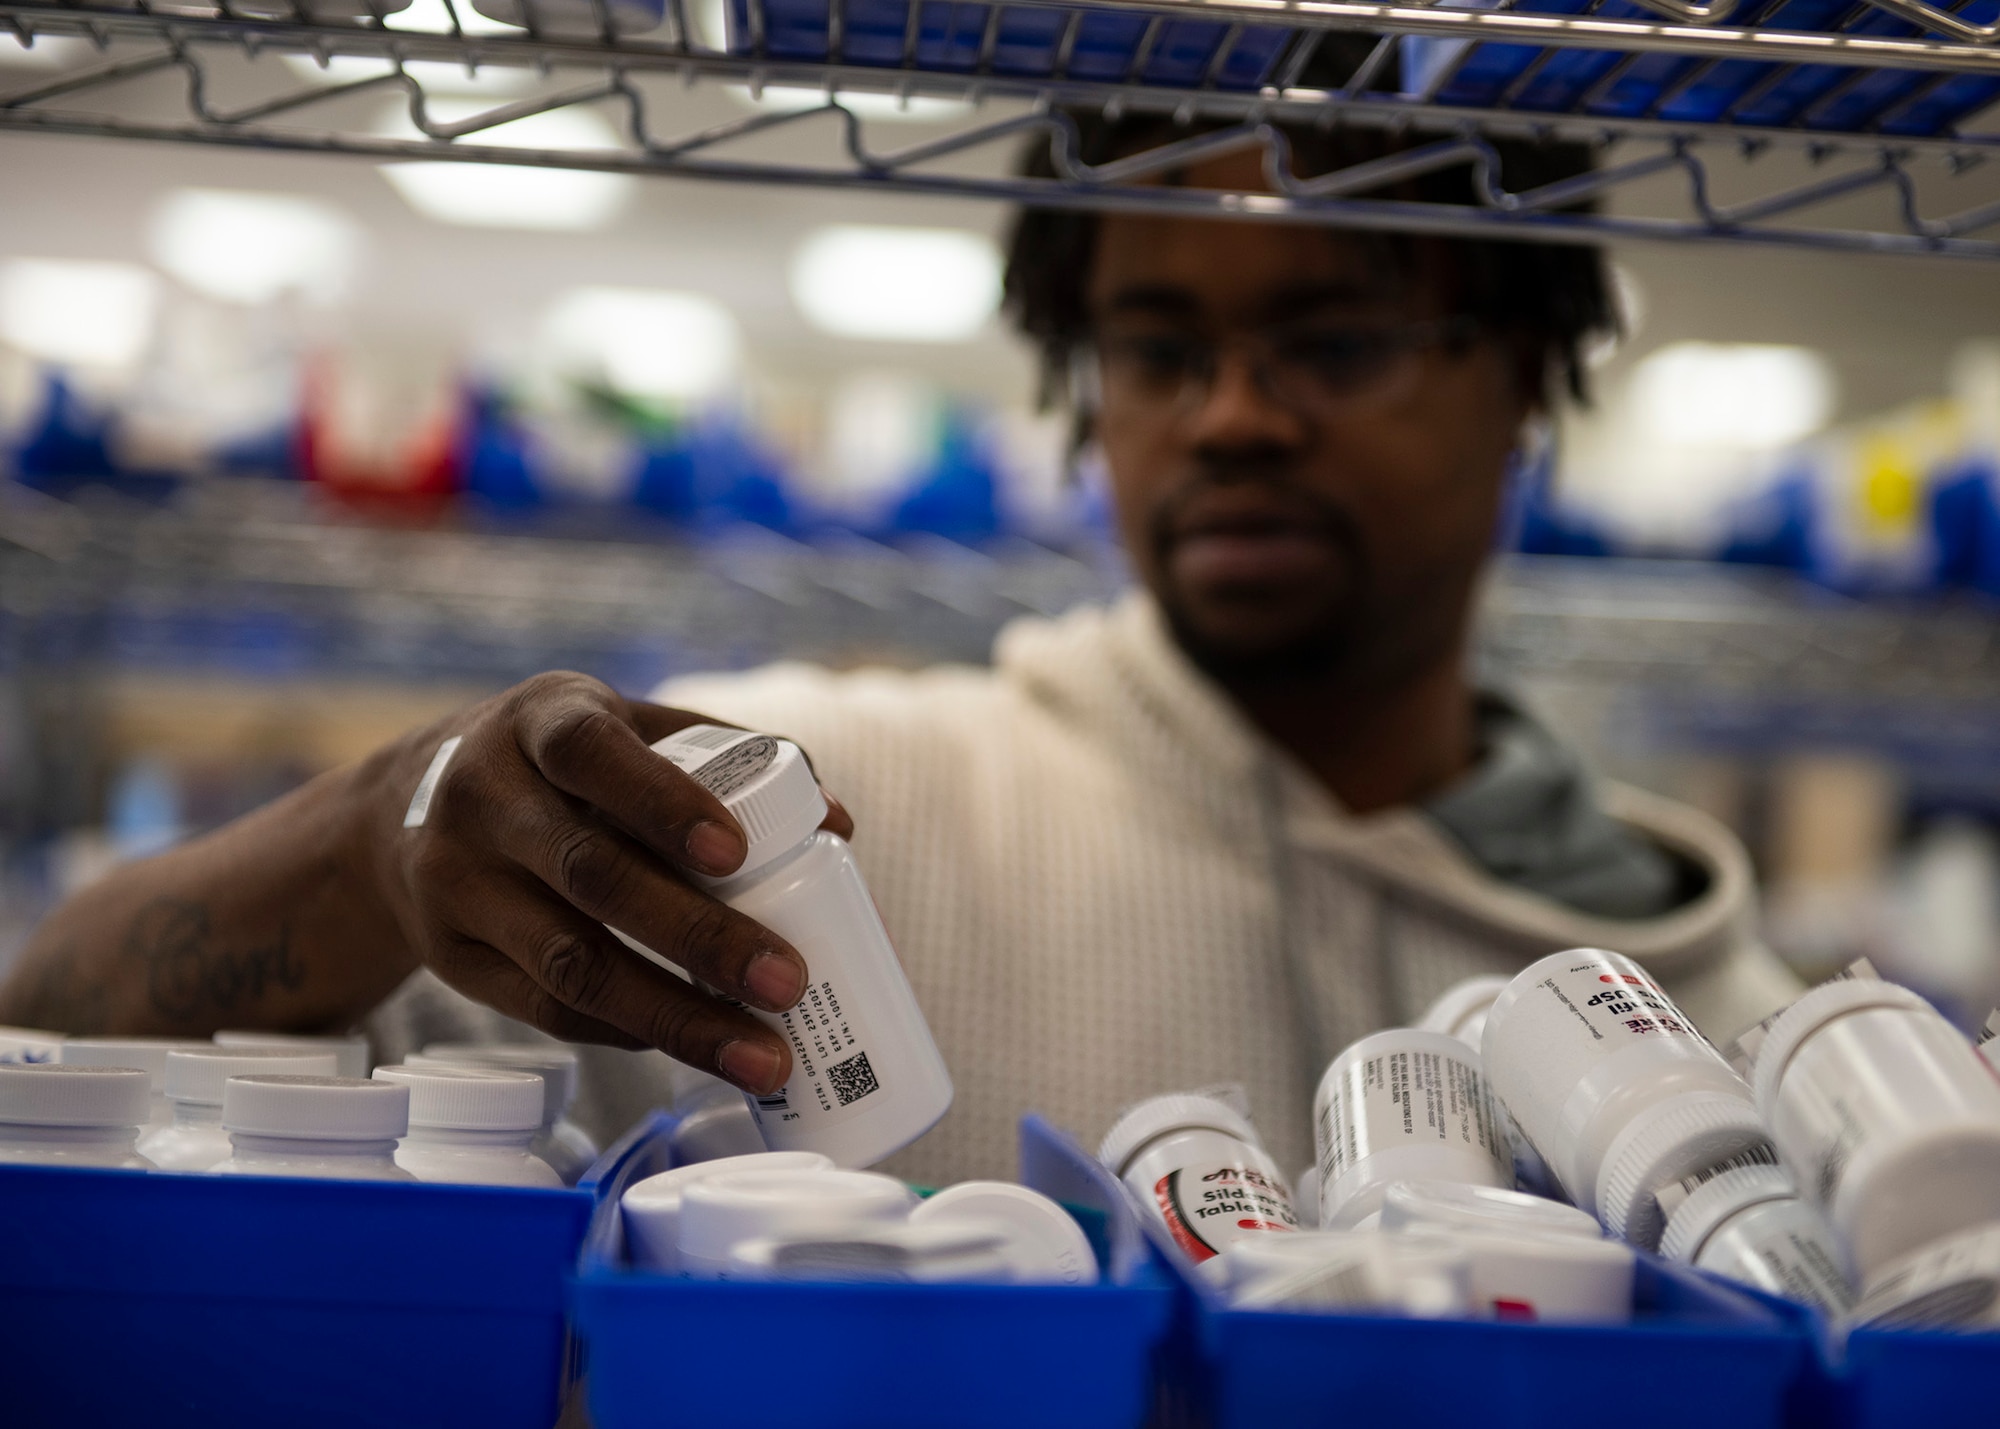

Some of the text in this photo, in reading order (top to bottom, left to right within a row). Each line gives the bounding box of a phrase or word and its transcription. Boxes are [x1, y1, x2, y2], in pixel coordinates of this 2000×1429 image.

[806, 983, 842, 1052] EXP: 01/2021
[821, 982, 855, 1045] S/N: 100500
[814, 1034, 828, 1059] LOT:
[814, 1082, 832, 1112] GTIN:
